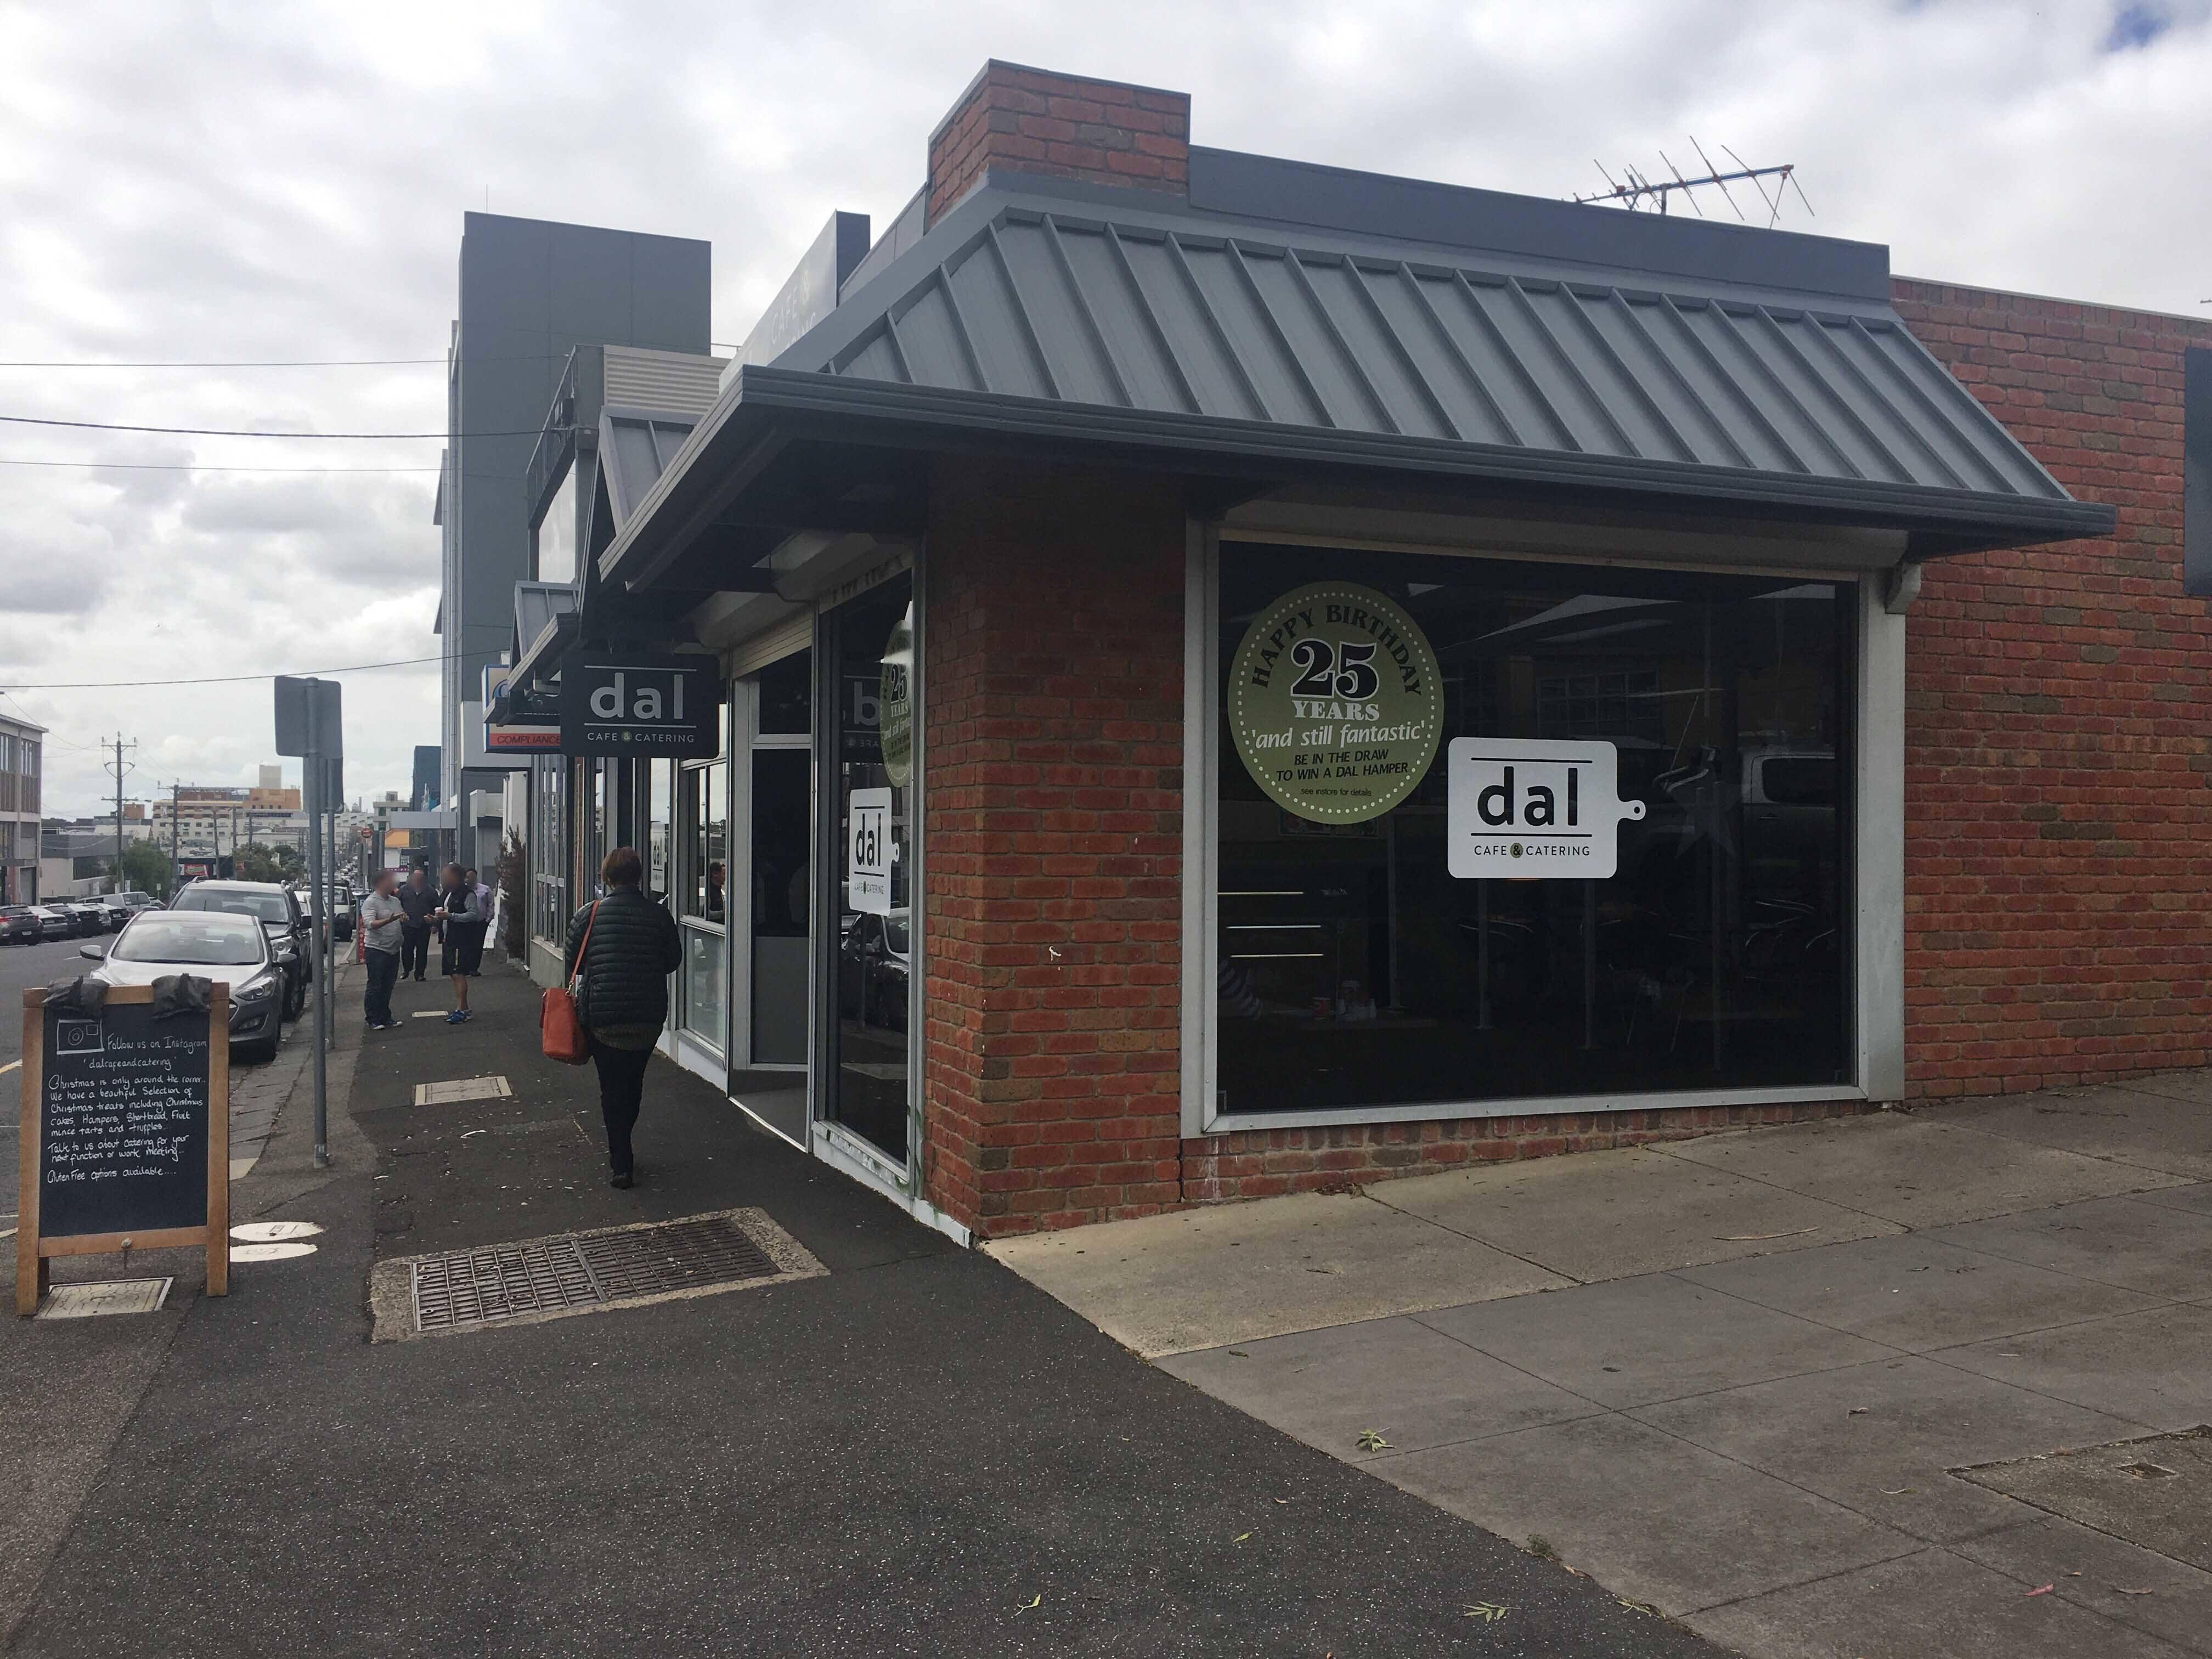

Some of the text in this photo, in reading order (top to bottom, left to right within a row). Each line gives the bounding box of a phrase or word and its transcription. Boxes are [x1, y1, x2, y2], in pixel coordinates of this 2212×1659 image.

[772, 286, 798, 345] CAFE
[1251, 604, 1422, 696] HAPPY BIRTHDAY
[1290, 637, 1380, 701] 25
[590, 672, 684, 719] dal
[1292, 700, 1380, 721] YEARS
[587, 732, 618, 741] CAFE
[635, 733, 694, 743] CATERING
[1251, 720, 1425, 748] 'and still fantastic'
[1294, 749, 1389, 766] BE IN THE DRAW
[1276, 762, 1408, 781] TO WIN A DAL HAMPER
[1351, 788, 1372, 797] details
[1477, 766, 1578, 826] dal
[856, 813, 881, 866] dal
[1474, 845, 1589, 856] CAFE & CATERING
[108, 1033, 133, 1050] Follow
[137, 1041, 146, 1049] us
[163, 1036, 207, 1054] Instagram
[48, 1074, 95, 1090] Christmas
[112, 1076, 130, 1090] only
[134, 1075, 163, 1084] around
[166, 1074, 178, 1083] the
[50, 1092, 63, 1101] We
[67, 1091, 85, 1099] have
[100, 1088, 136, 1100] beautiful
[142, 1086, 180, 1095] Selection
[184, 1087, 193, 1098] of
[50, 1097, 203, 1113] Christmas treats including Christmas
[171, 1110, 190, 1119] Fruit
[51, 1128, 75, 1137] mince
[109, 1125, 124, 1133] and
[48, 1142, 70, 1153] Talk
[71, 1142, 79, 1151] to
[98, 1138, 120, 1149] about
[123, 1138, 154, 1150] catering
[157, 1137, 167, 1148] for
[171, 1135, 189, 1149] your
[51, 1154, 69, 1163] next
[70, 1151, 103, 1166] function
[119, 1148, 141, 1158] work
[91, 1167, 117, 1182] options
